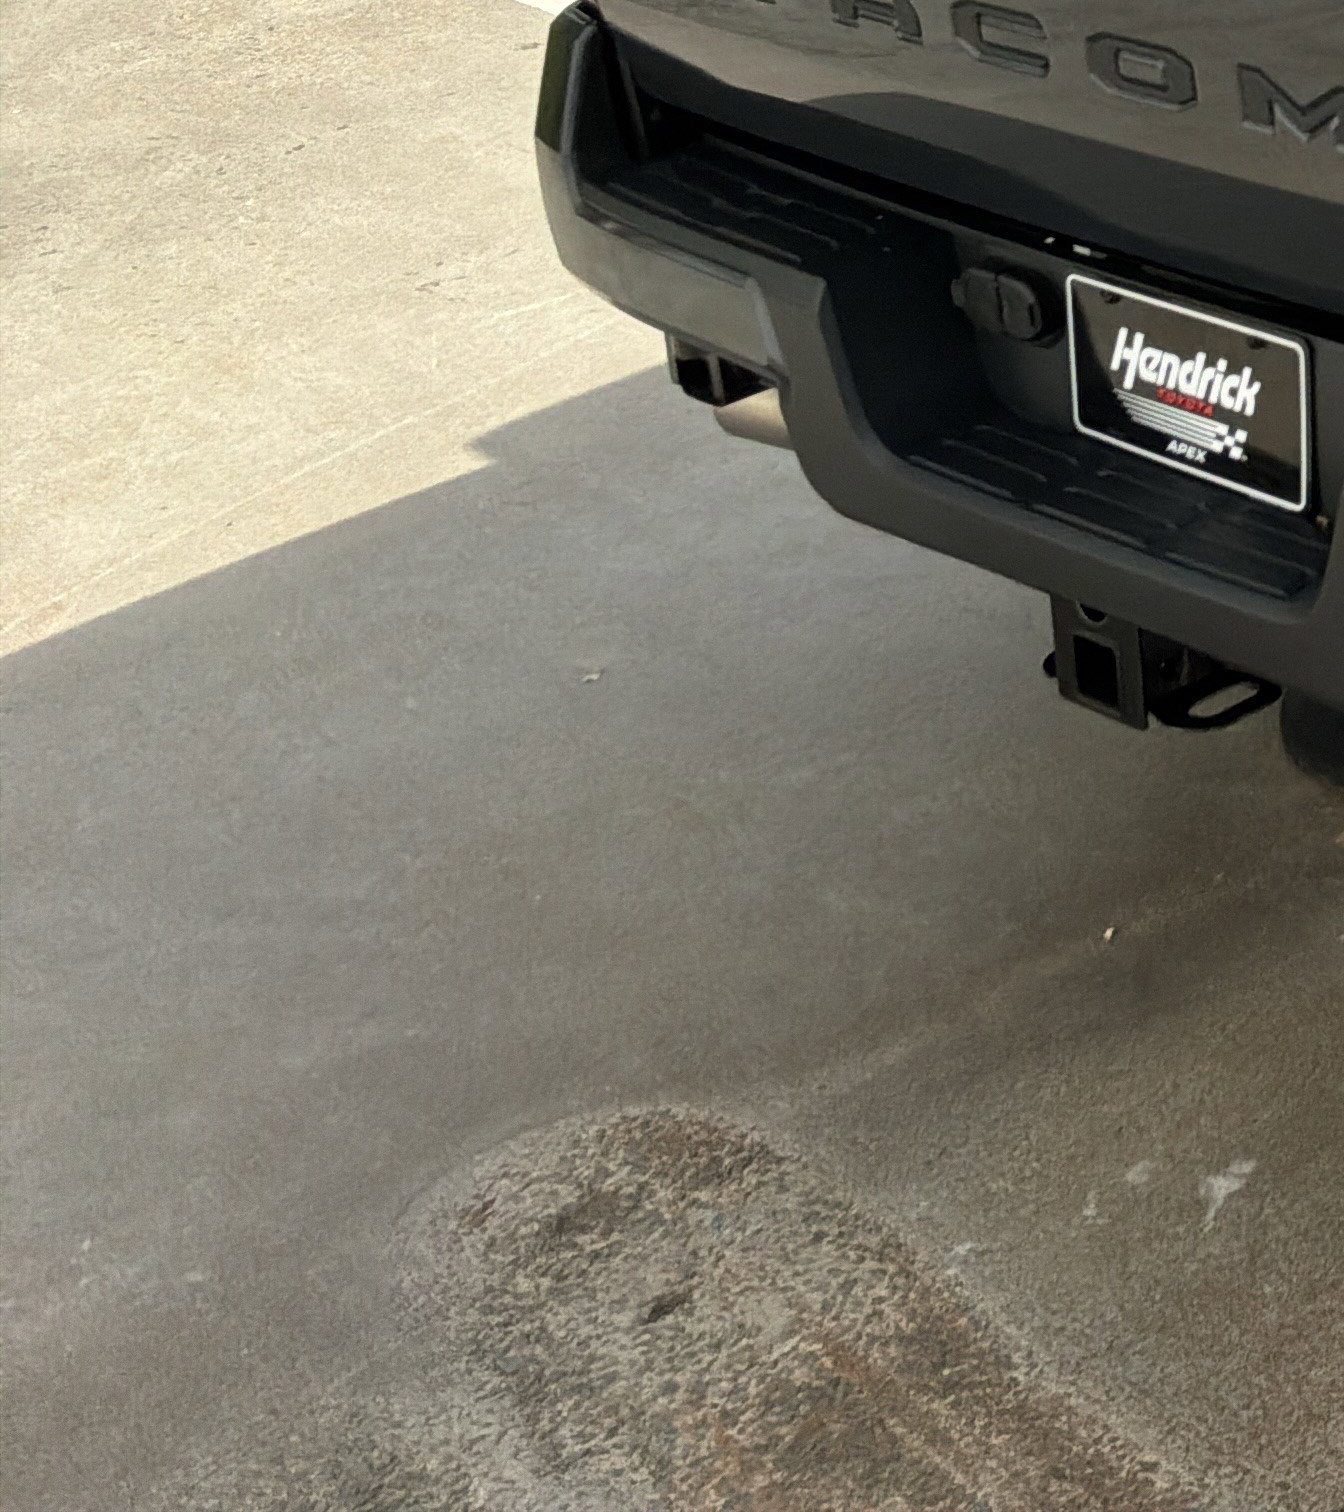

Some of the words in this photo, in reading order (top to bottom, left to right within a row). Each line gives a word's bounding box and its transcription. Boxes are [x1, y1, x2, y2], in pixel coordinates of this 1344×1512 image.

[1110, 326, 1262, 417] Hendrick
[1156, 386, 1215, 418] TOYOTA
[1165, 439, 1207, 464] APEX
